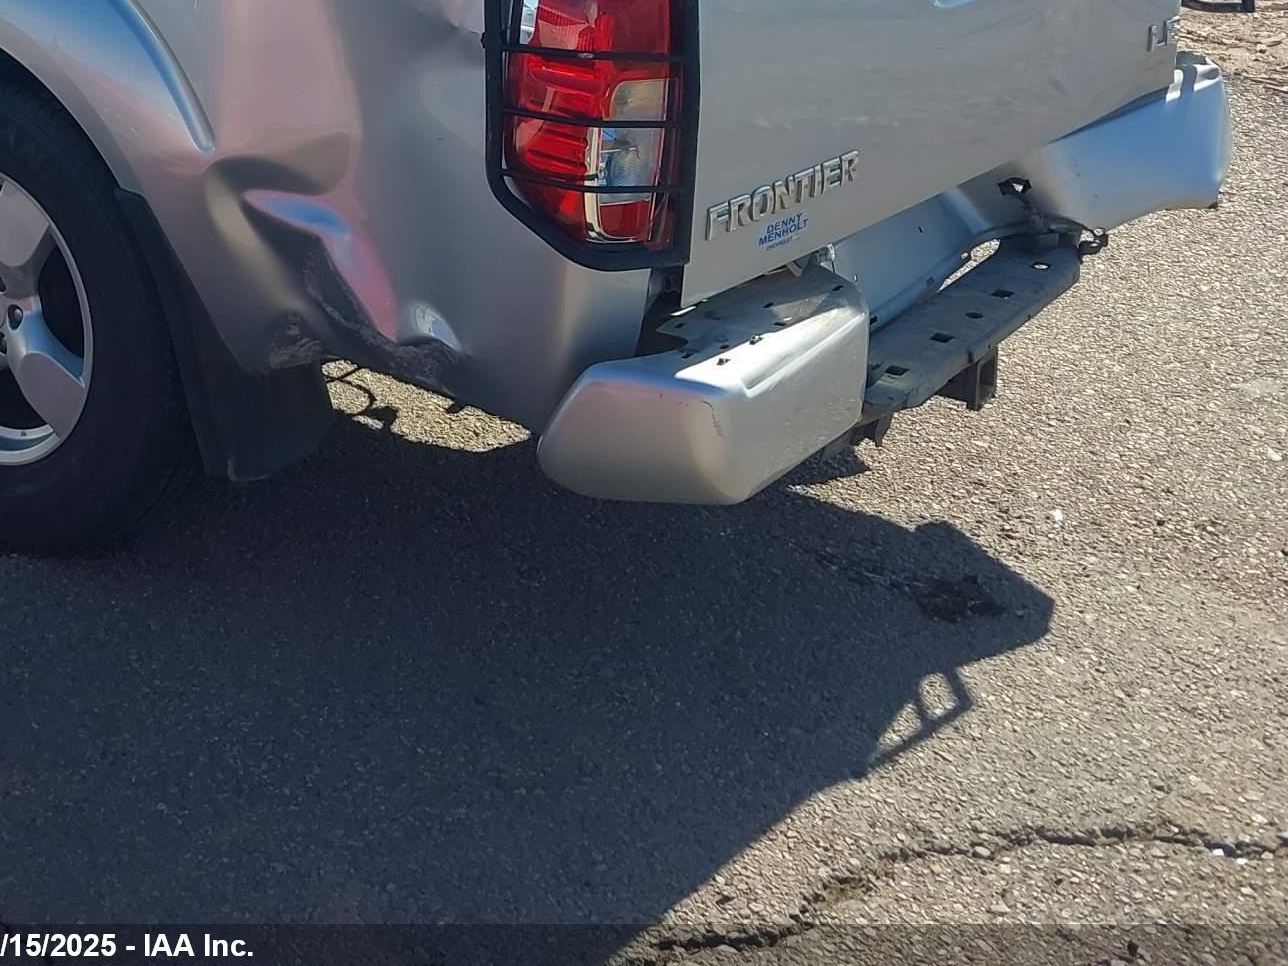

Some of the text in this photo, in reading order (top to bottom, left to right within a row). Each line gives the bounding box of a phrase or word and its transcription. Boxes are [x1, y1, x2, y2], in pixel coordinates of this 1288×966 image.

[705, 149, 860, 241] FRONTIER
[758, 218, 809, 247] MENHOLT
[766, 212, 803, 234] DENNY
